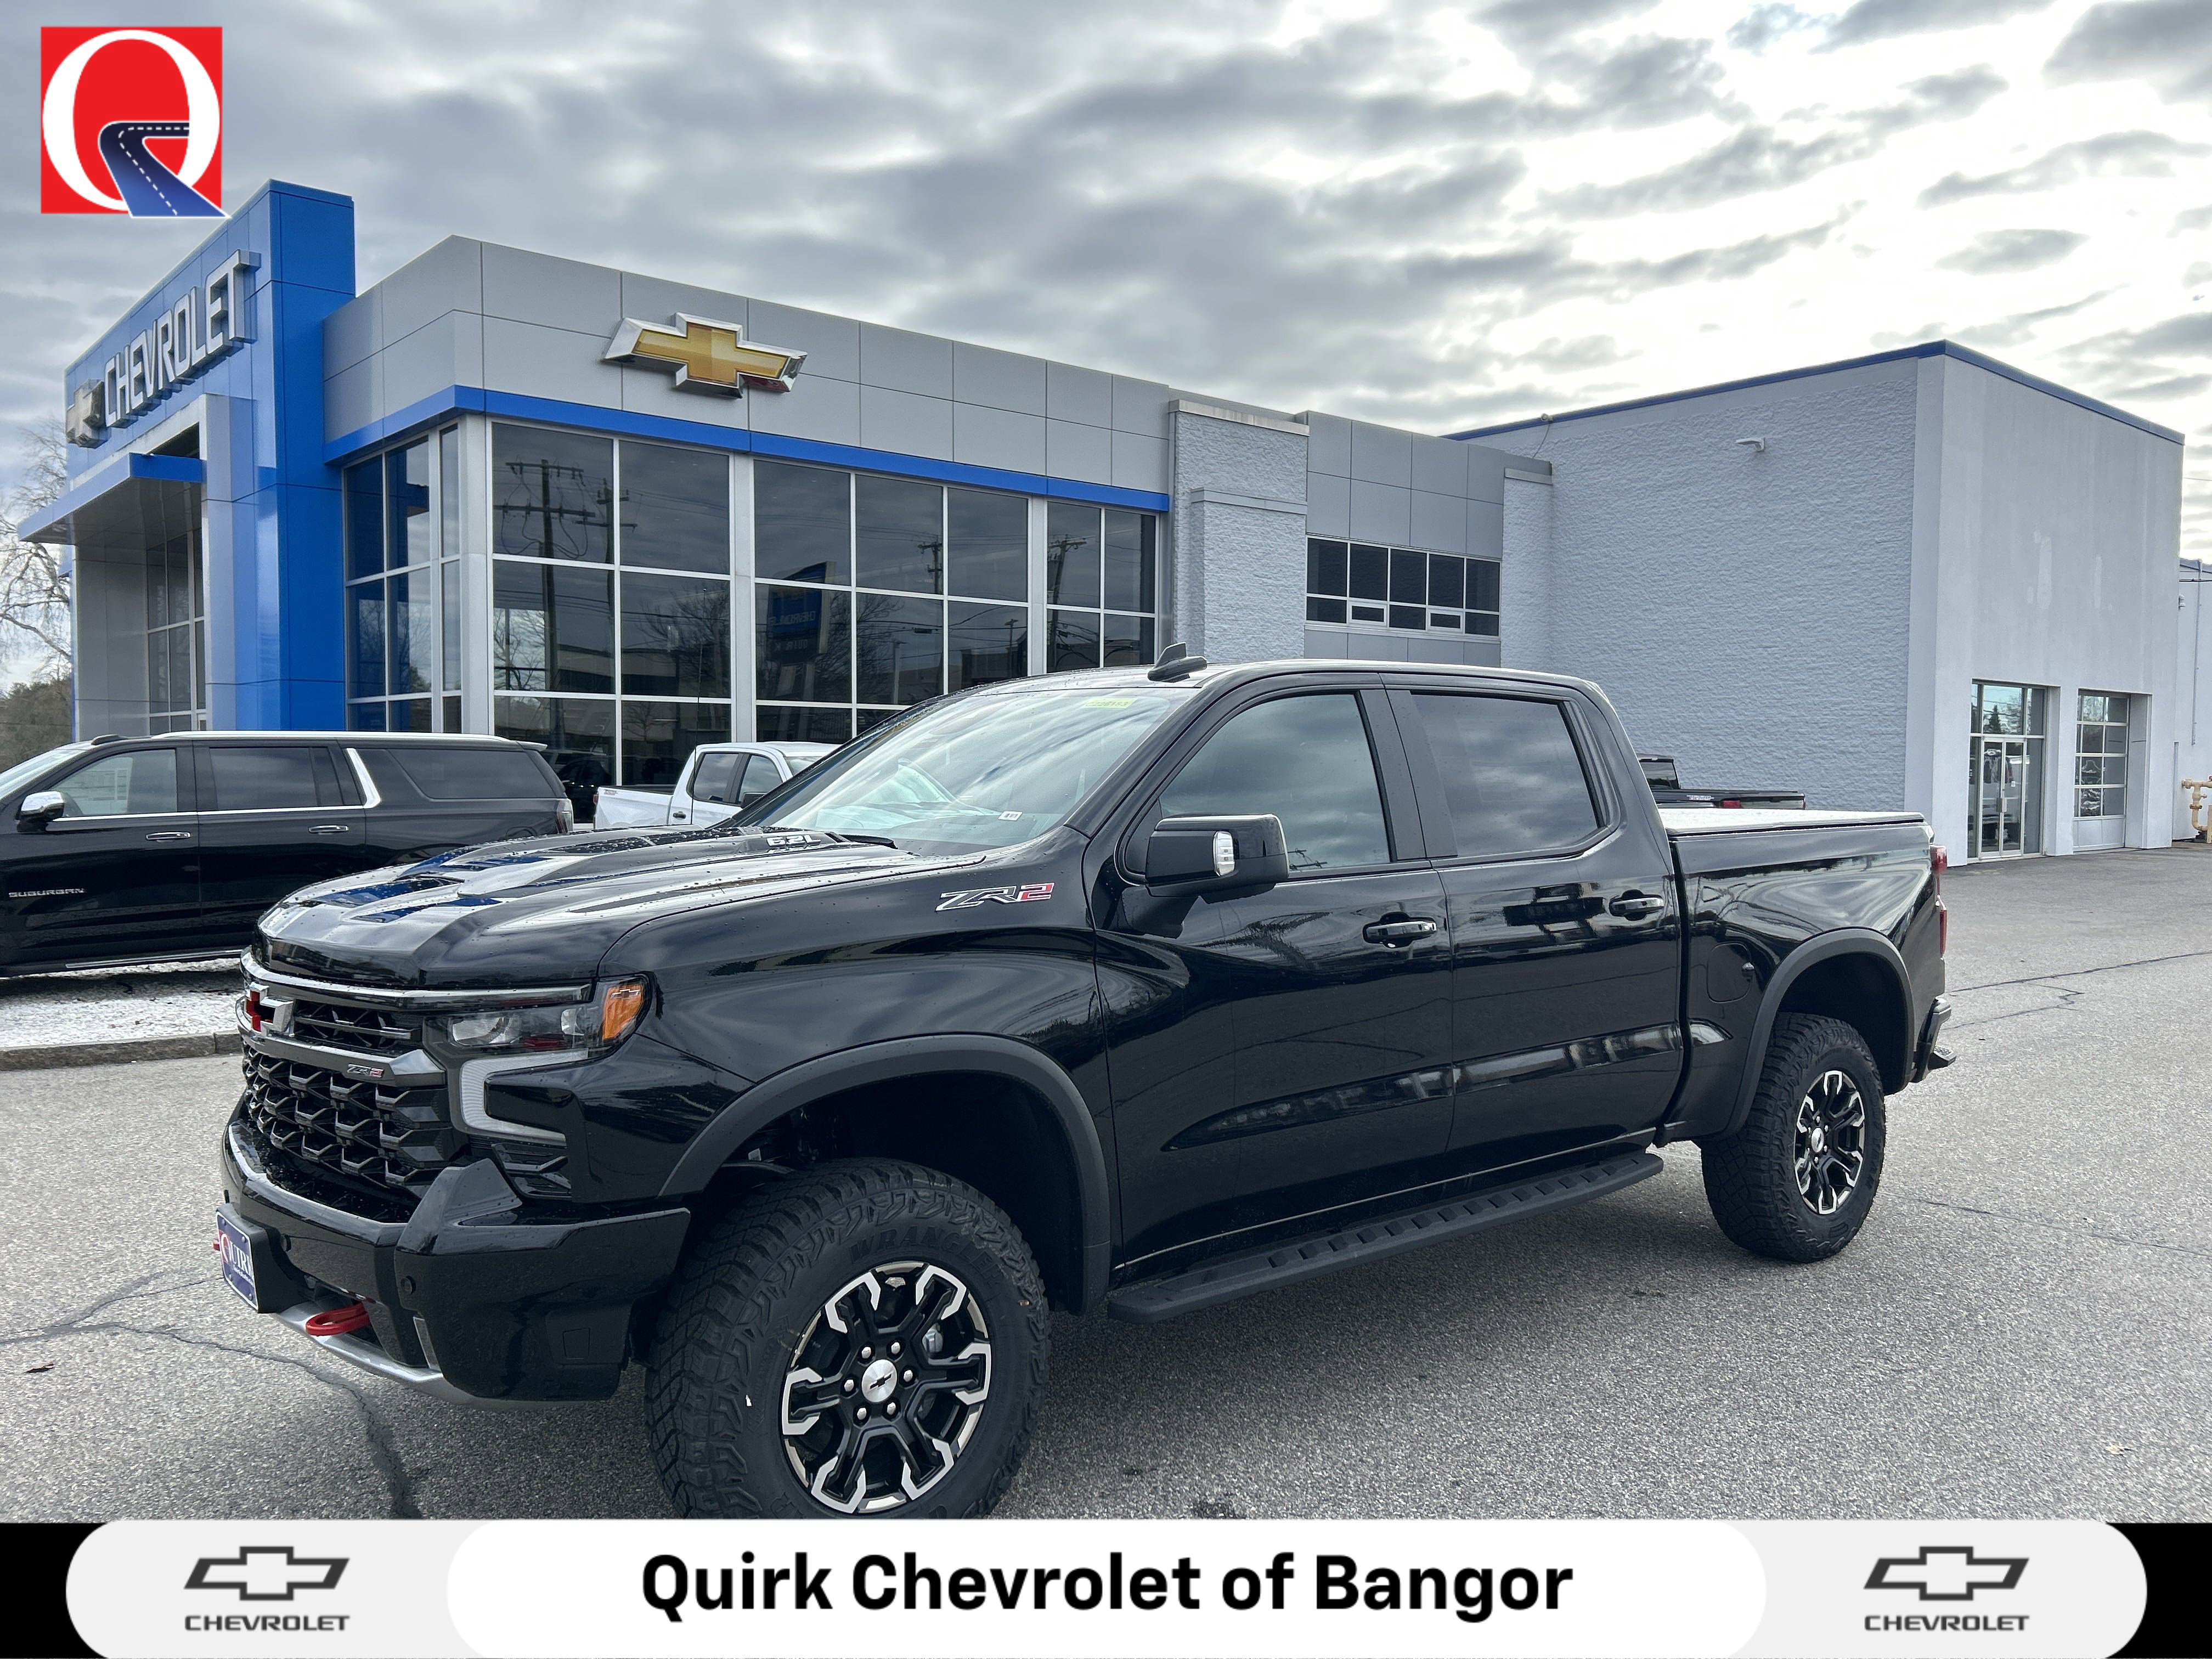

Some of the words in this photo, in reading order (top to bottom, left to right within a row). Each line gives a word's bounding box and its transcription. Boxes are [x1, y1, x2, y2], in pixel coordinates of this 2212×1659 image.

[104, 249, 261, 428] CHEVROLET
[8, 888, 85, 898] SUBURBAN
[934, 882, 1055, 912] ZR2
[347, 1063, 383, 1078] ZR2
